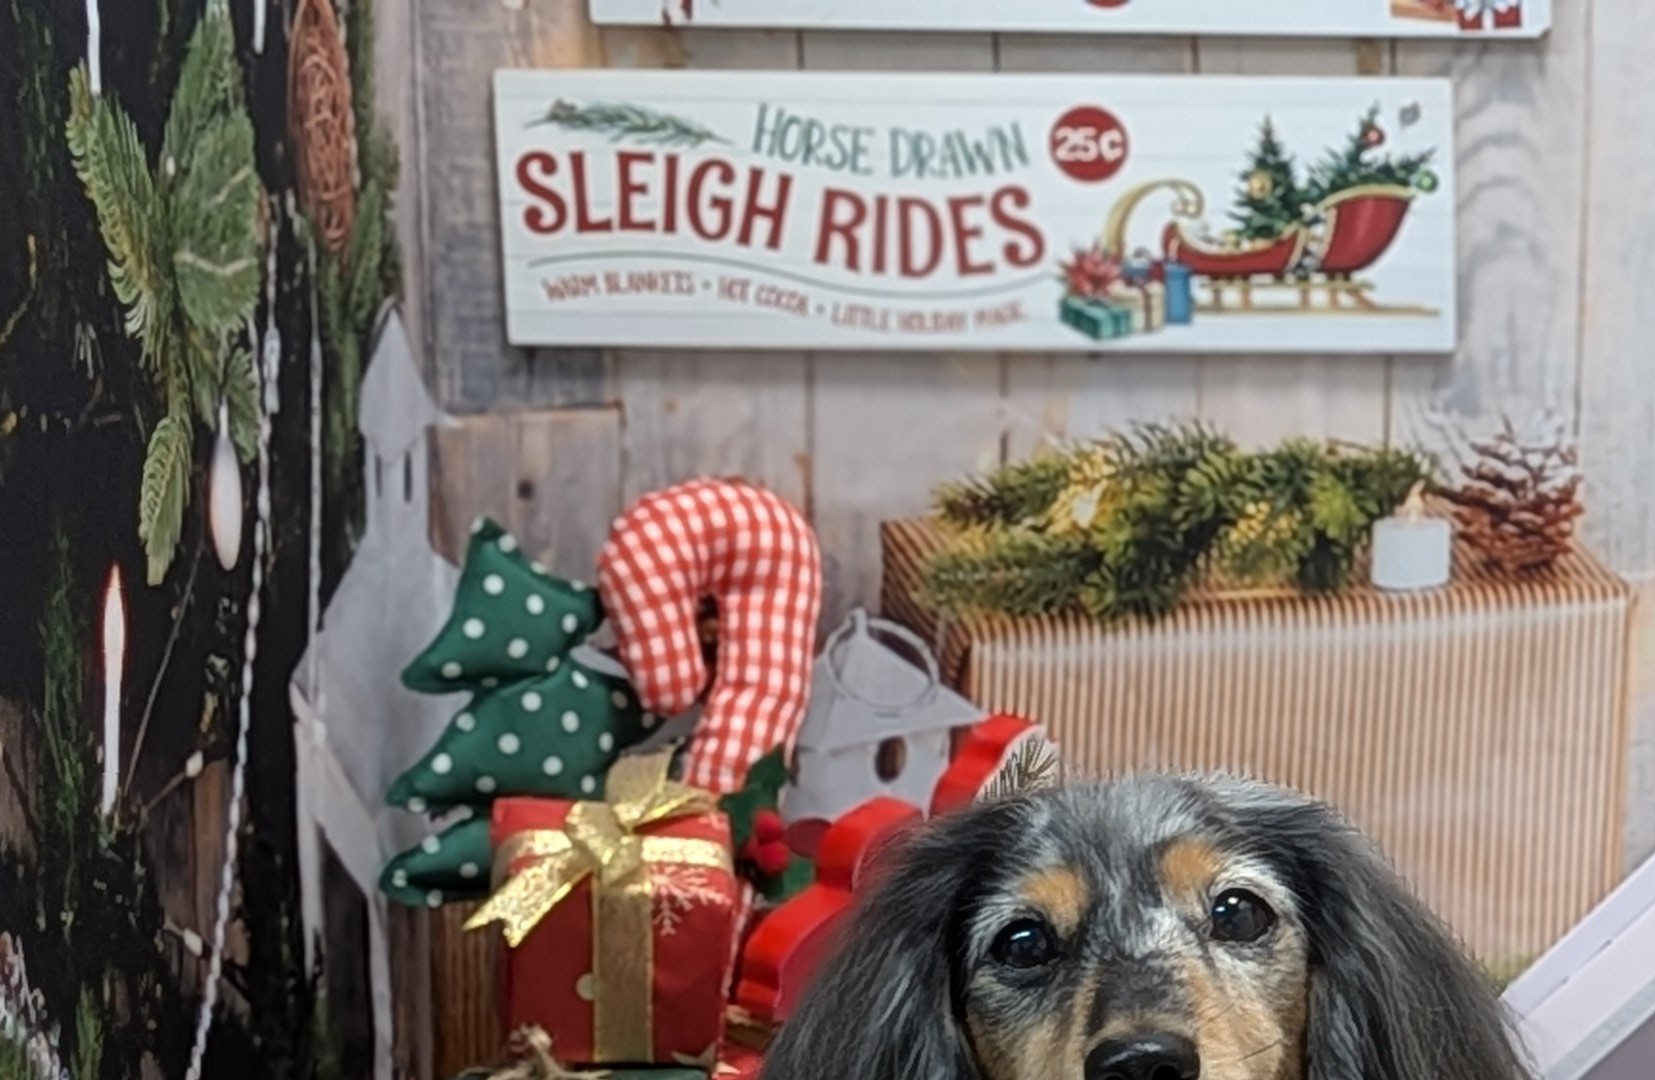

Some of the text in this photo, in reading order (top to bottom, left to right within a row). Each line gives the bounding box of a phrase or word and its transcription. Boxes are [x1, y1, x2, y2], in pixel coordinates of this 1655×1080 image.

[752, 103, 1030, 179] HORSE DRAWN
[515, 151, 1046, 279] SLEIGH RIDES
